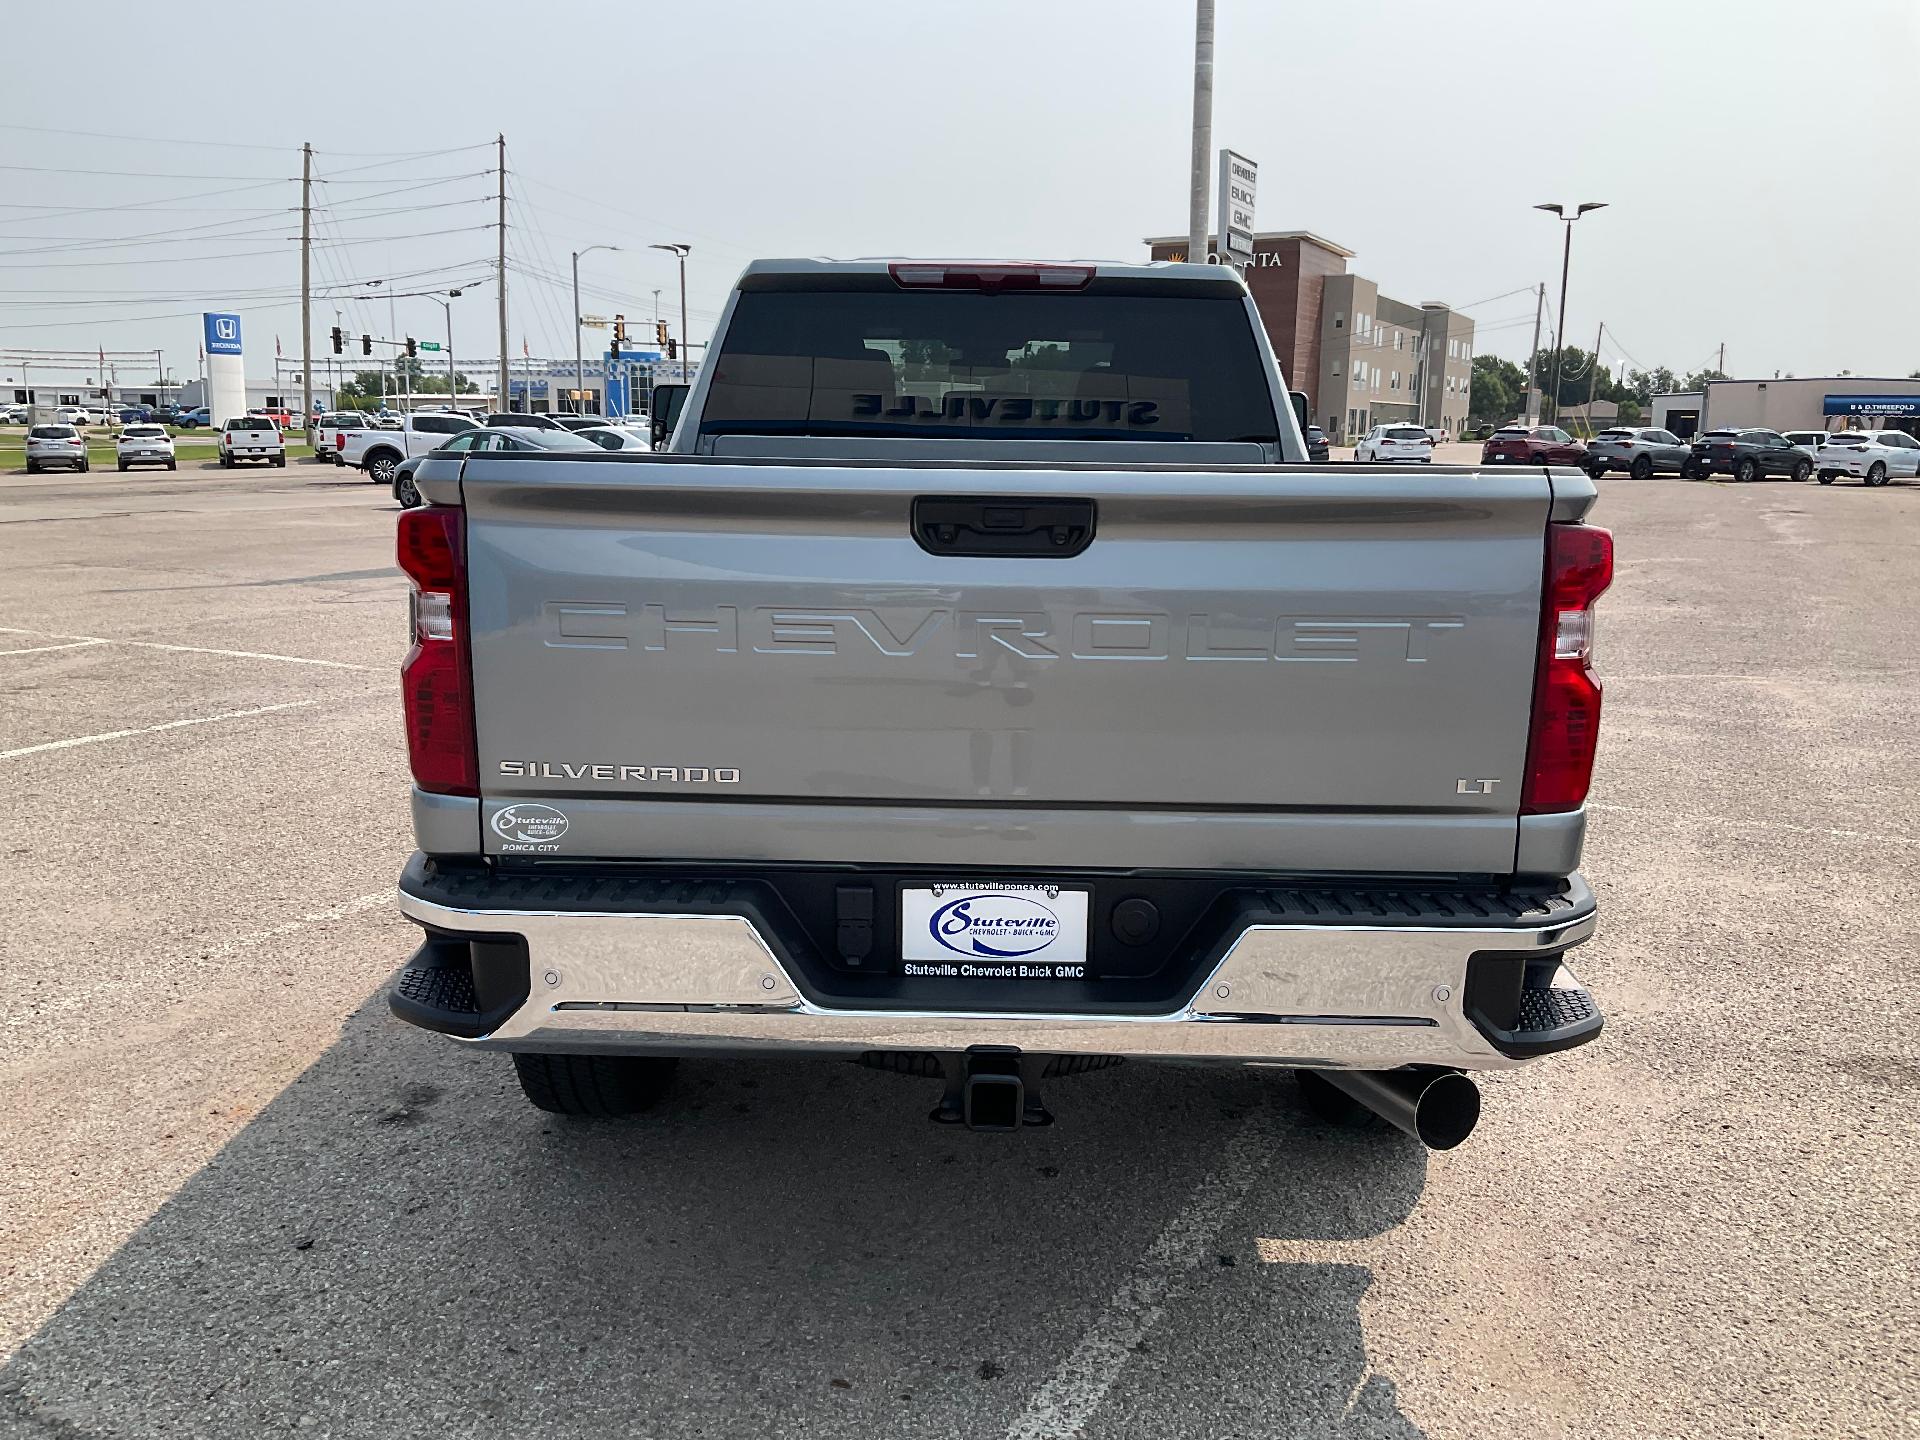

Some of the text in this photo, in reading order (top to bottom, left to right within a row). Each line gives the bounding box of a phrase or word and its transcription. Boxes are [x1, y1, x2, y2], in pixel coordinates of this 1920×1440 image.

[1232, 163, 1256, 183] CHEVROLET
[1231, 185, 1255, 207] BUICK
[1234, 210, 1251, 229] GMC
[211, 342, 241, 350] HONDA
[543, 599, 1467, 664] CHEVROLET
[499, 760, 741, 784] SILVERADO
[1456, 778, 1501, 795] LT
[499, 808, 566, 829] Stuteville
[538, 844, 560, 852] CITY
[933, 882, 1059, 891] www.stutevilleponca.com
[941, 902, 1057, 935] Stuteville
[969, 928, 1008, 936] CHEVROLET
[904, 964, 1085, 978] Stuteville Chevrolet Buick GMC
